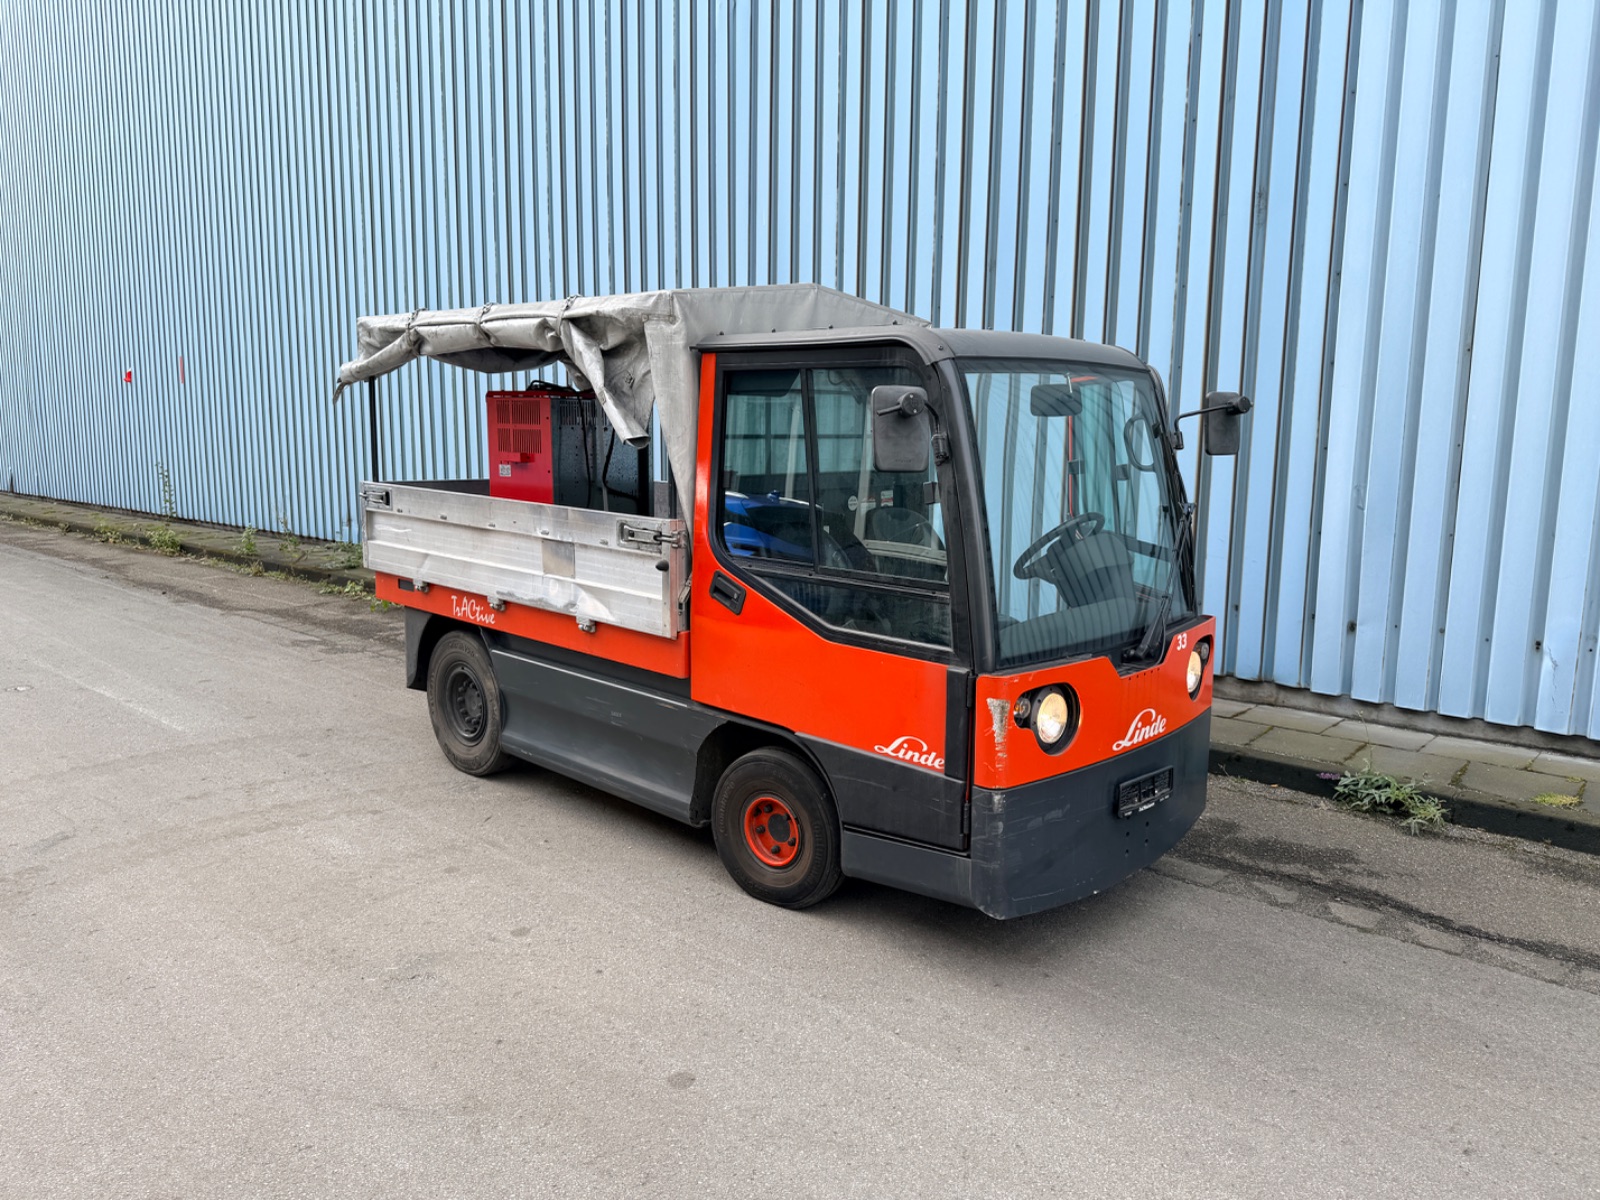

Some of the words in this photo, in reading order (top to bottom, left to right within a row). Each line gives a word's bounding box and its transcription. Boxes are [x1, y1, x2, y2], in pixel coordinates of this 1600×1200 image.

[1177, 632, 1188, 651] 33
[1112, 708, 1167, 751] Linde
[874, 735, 945, 770] Linde
